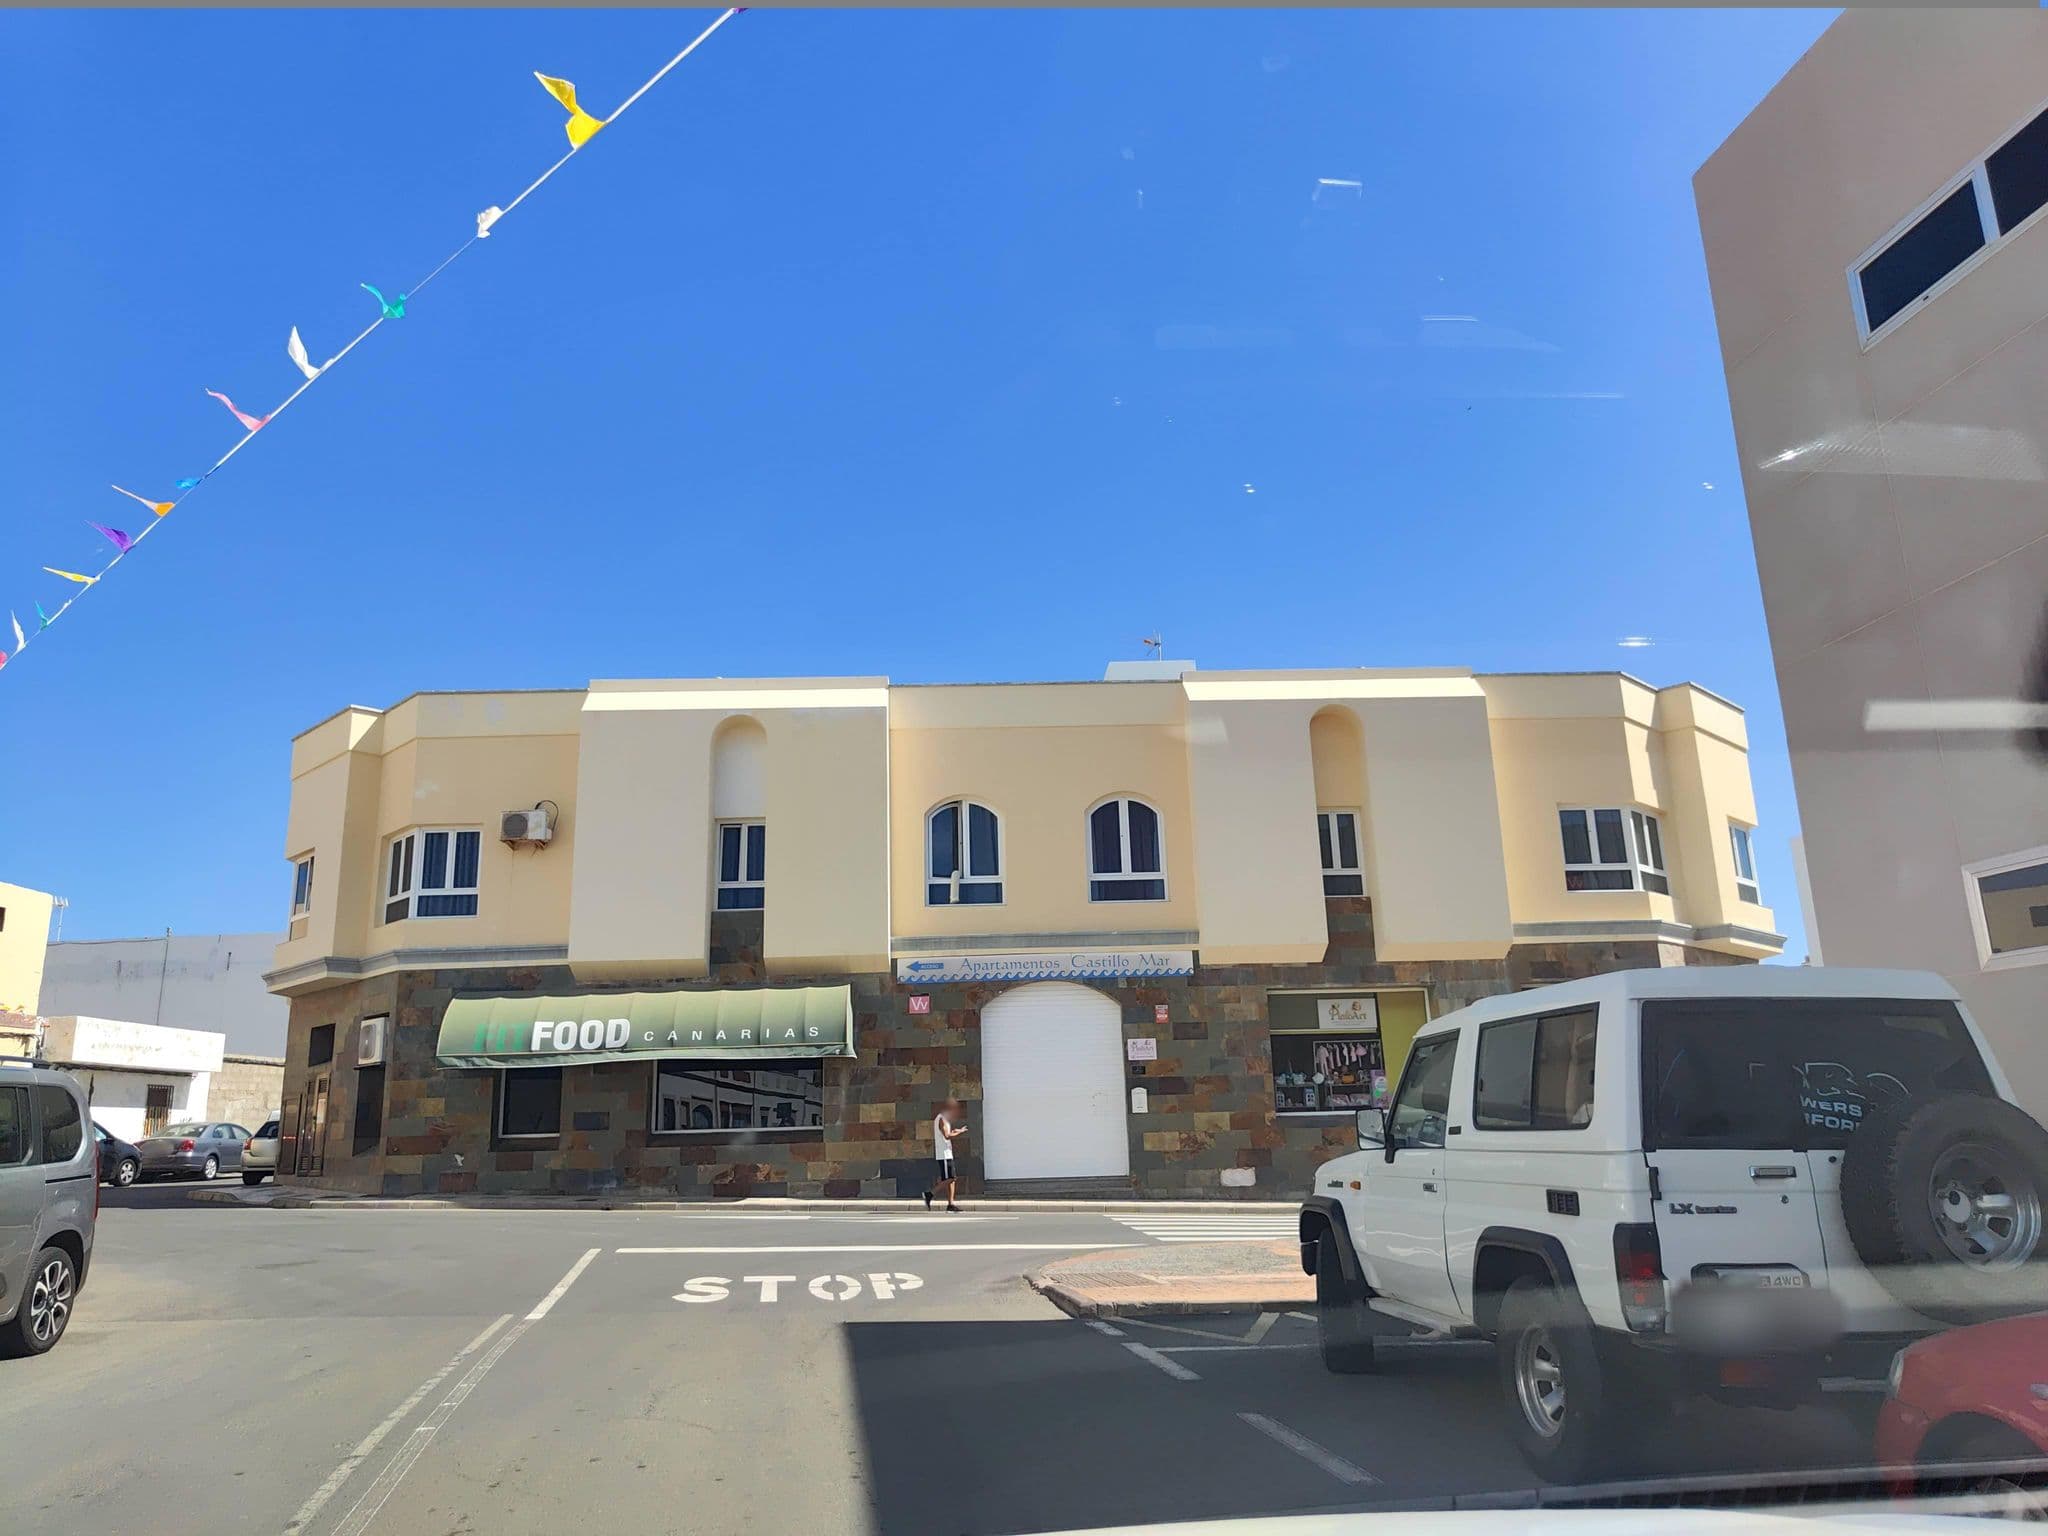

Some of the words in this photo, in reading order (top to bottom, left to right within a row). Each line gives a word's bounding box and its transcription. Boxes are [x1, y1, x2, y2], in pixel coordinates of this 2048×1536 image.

[960, 957, 1060, 973] Apartamentos
[1071, 954, 1130, 969] Castillo
[1139, 952, 1170, 967] Mar
[643, 1026, 819, 1042] CANARIAS
[672, 1272, 925, 1304] STOP
